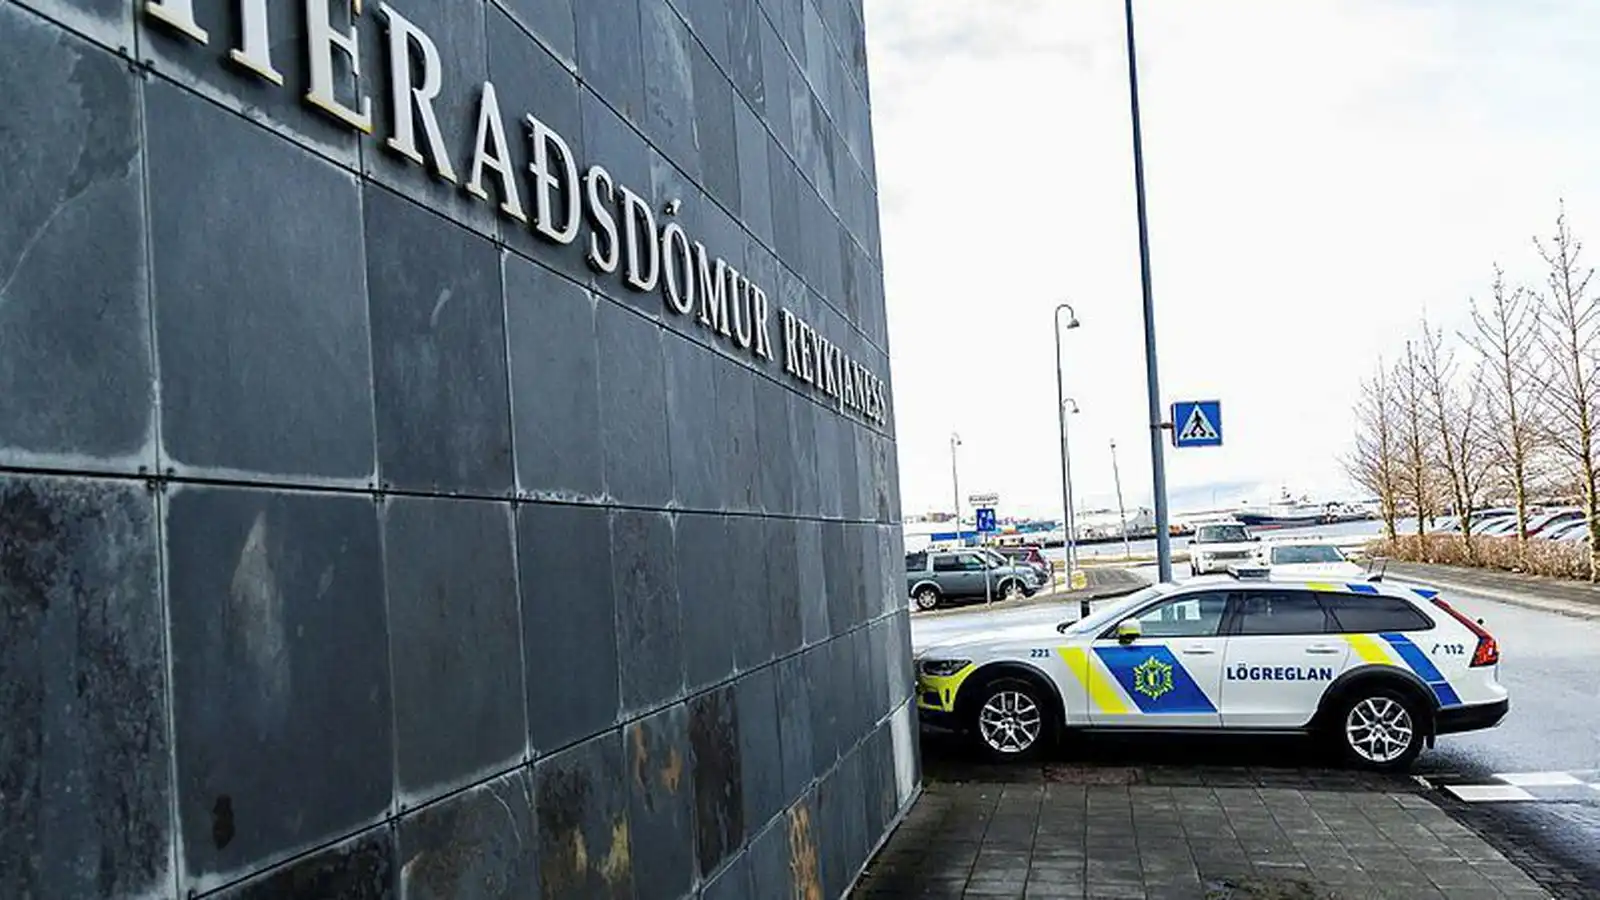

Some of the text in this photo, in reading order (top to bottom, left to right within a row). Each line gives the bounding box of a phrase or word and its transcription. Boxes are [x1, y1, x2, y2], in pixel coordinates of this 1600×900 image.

[782, 307, 887, 426] REYKJANESS
[1030, 648, 1050, 658] 221
[1443, 643, 1465, 655] 112
[1226, 662, 1333, 681] LÖGREGLAN
